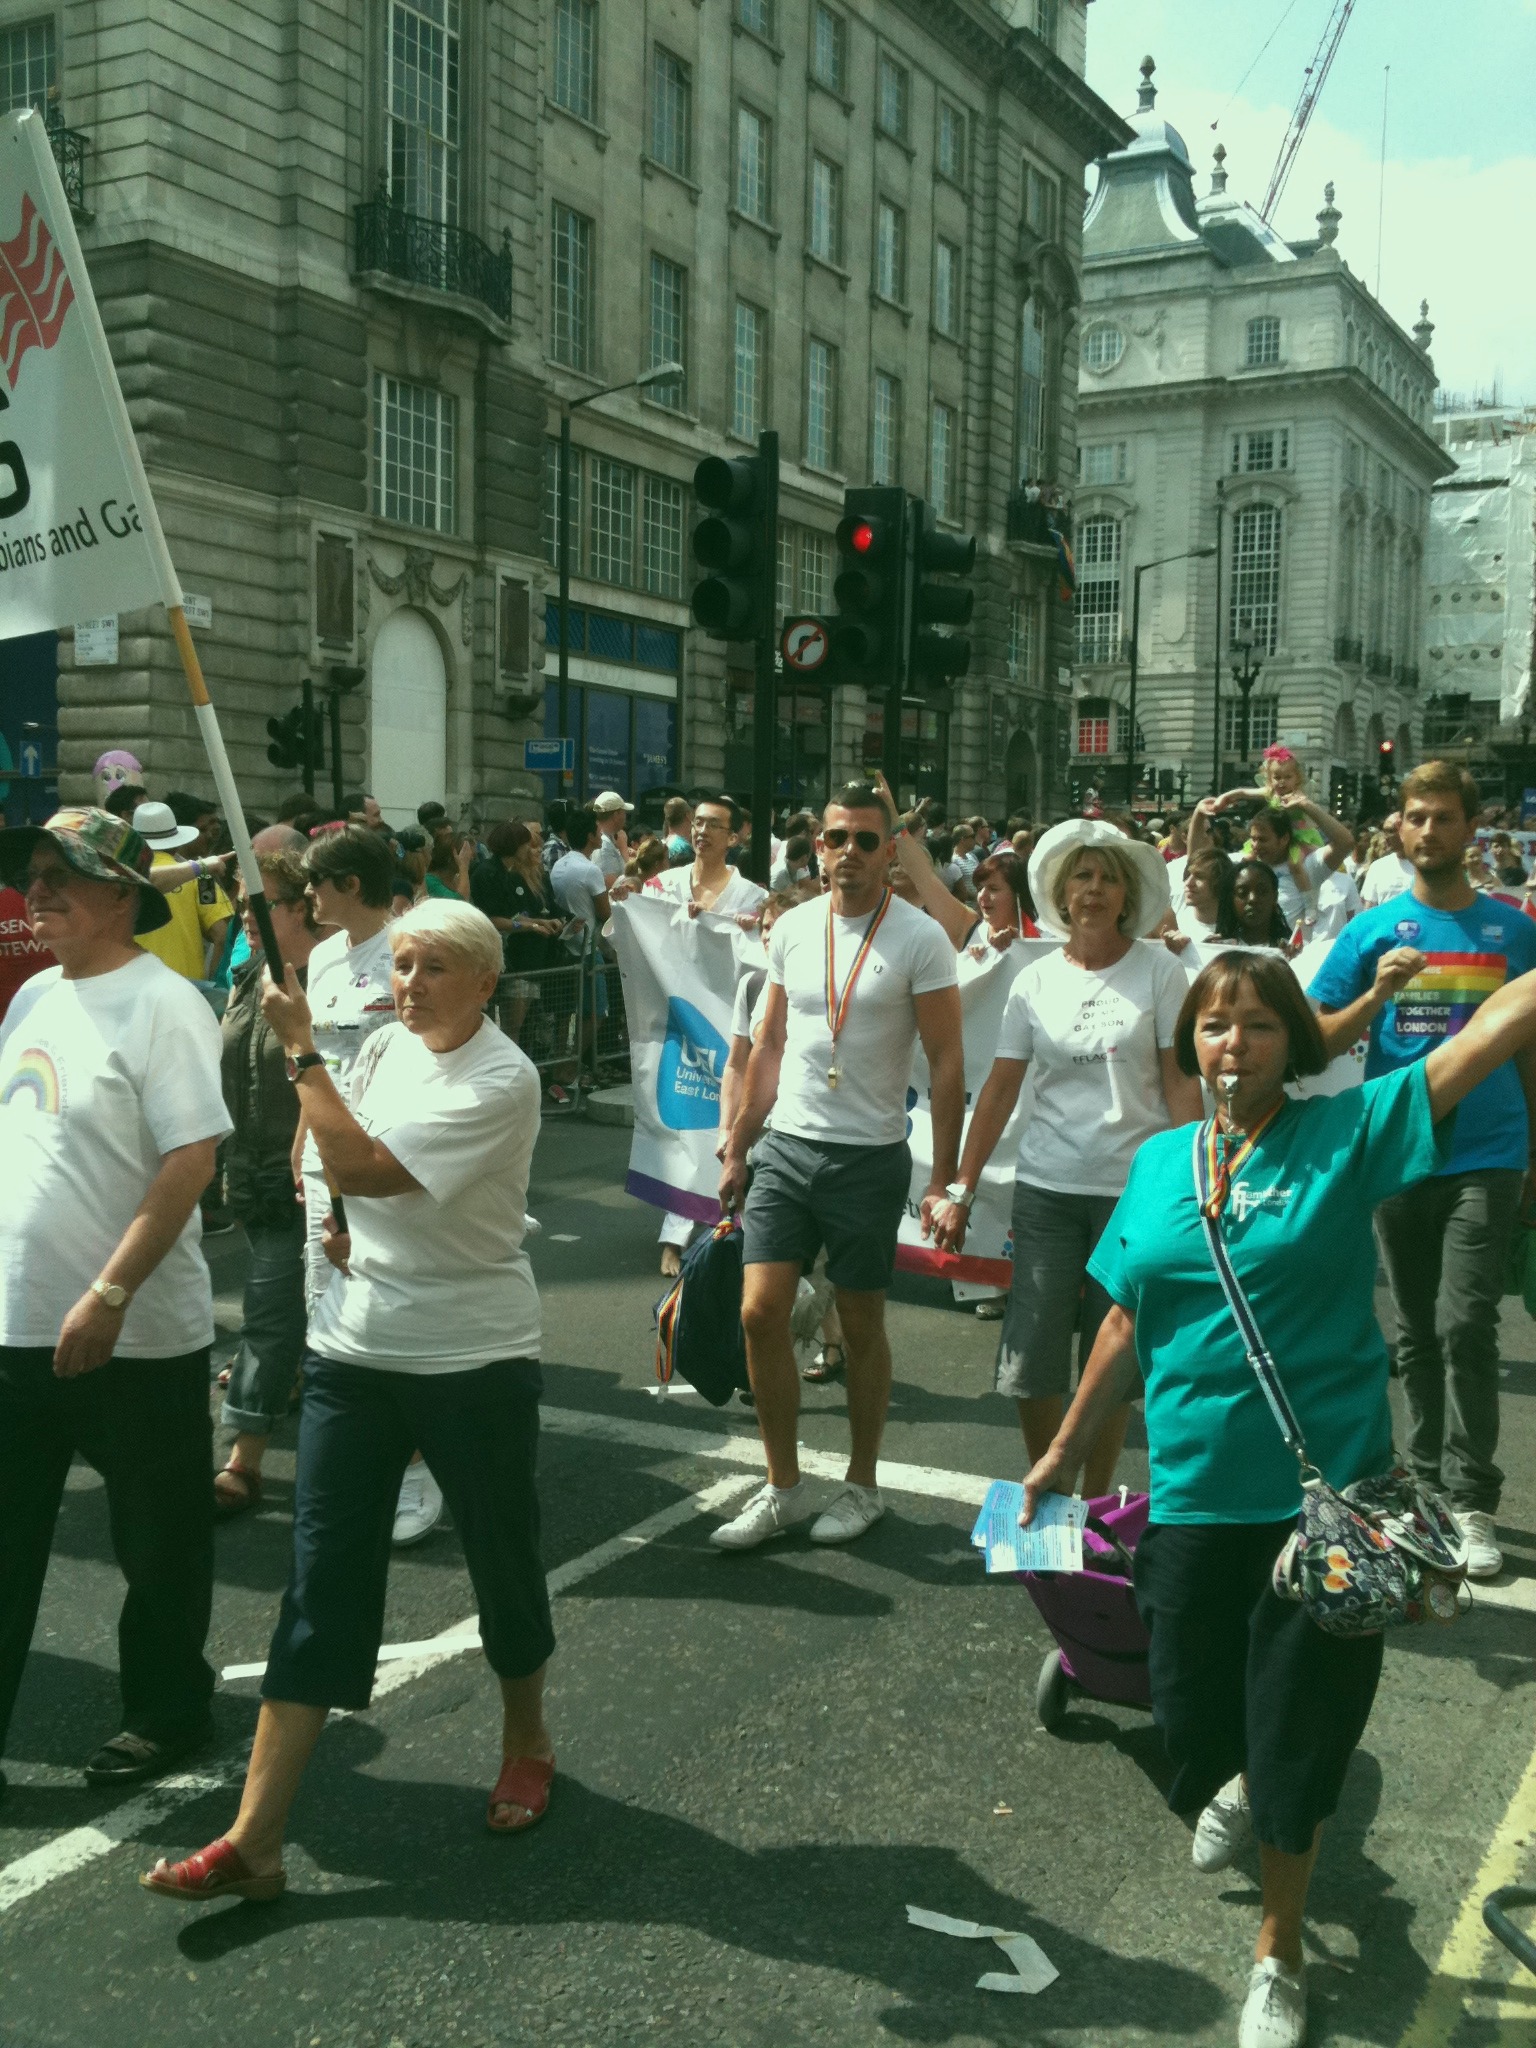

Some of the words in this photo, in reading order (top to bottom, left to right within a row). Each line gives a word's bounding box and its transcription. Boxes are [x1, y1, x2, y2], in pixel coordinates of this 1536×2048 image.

[48, 506, 99, 557] and
[0, 939, 50, 956] TEW
[1400, 1006, 1451, 1016] TOGETHER
[1396, 1022, 1447, 1033] LONDON
[674, 1080, 700, 1098] East
